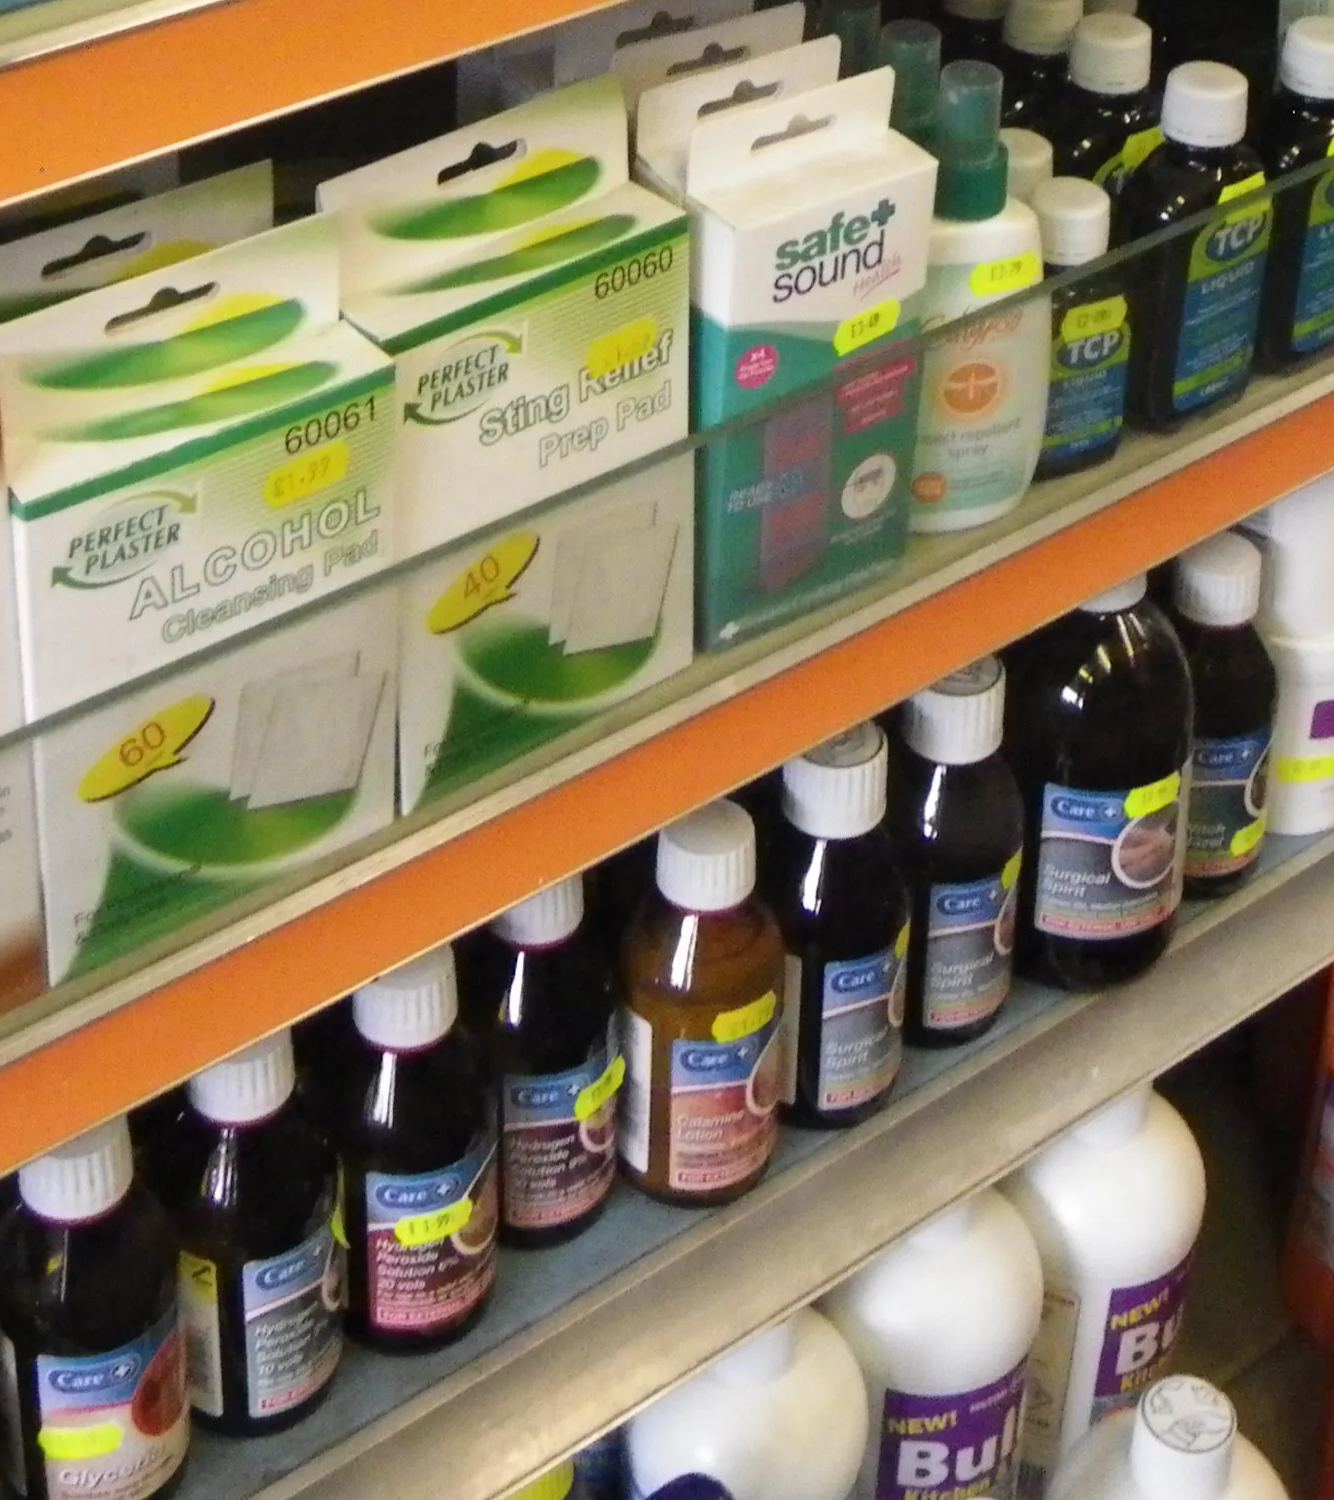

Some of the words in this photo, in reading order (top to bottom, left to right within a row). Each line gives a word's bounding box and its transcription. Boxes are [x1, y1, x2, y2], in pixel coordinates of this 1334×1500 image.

[1215, 217, 1264, 257] TCP
[593, 244, 675, 300] 60060
[772, 229, 886, 303] sound
[1201, 260, 1255, 295] LIQUID
[1067, 331, 1120, 363] TCP
[416, 342, 501, 395] PERFECT
[431, 363, 512, 414] PLASTER
[478, 377, 573, 446] Sting
[578, 330, 675, 404] Relief
[284, 396, 378, 456] 60061
[537, 414, 611, 469] Prep
[615, 383, 674, 434] Pad
[67, 506, 169, 559] PERFECT
[83, 522, 182, 575] PLASTER
[130, 488, 381, 620] ALCOHOL
[161, 556, 315, 644] Cleansing
[322, 529, 380, 578] Pad
[463, 553, 502, 599] 40
[119, 722, 167, 769] 60
[1198, 749, 1234, 764] Care
[1056, 801, 1097, 819] Care
[1043, 864, 1112, 885] Surgical
[1043, 879, 1087, 899] Spirit
[943, 896, 980, 911] Care
[837, 969, 876, 988] Care
[686, 1051, 728, 1067] Care
[517, 1089, 559, 1103] Care
[676, 1110, 745, 1128] Calamine
[510, 1135, 576, 1153] Hydrogen
[677, 1126, 724, 1142] Lotion
[511, 1149, 570, 1163] Peroxide
[383, 1186, 429, 1203] Care
[375, 1250, 440, 1267] Peroxide
[377, 1262, 436, 1278] Solution
[263, 1262, 307, 1285] Care
[1109, 1288, 1169, 1331] NEW!
[57, 1369, 106, 1388] Care
[887, 1412, 958, 1436] NEW!
